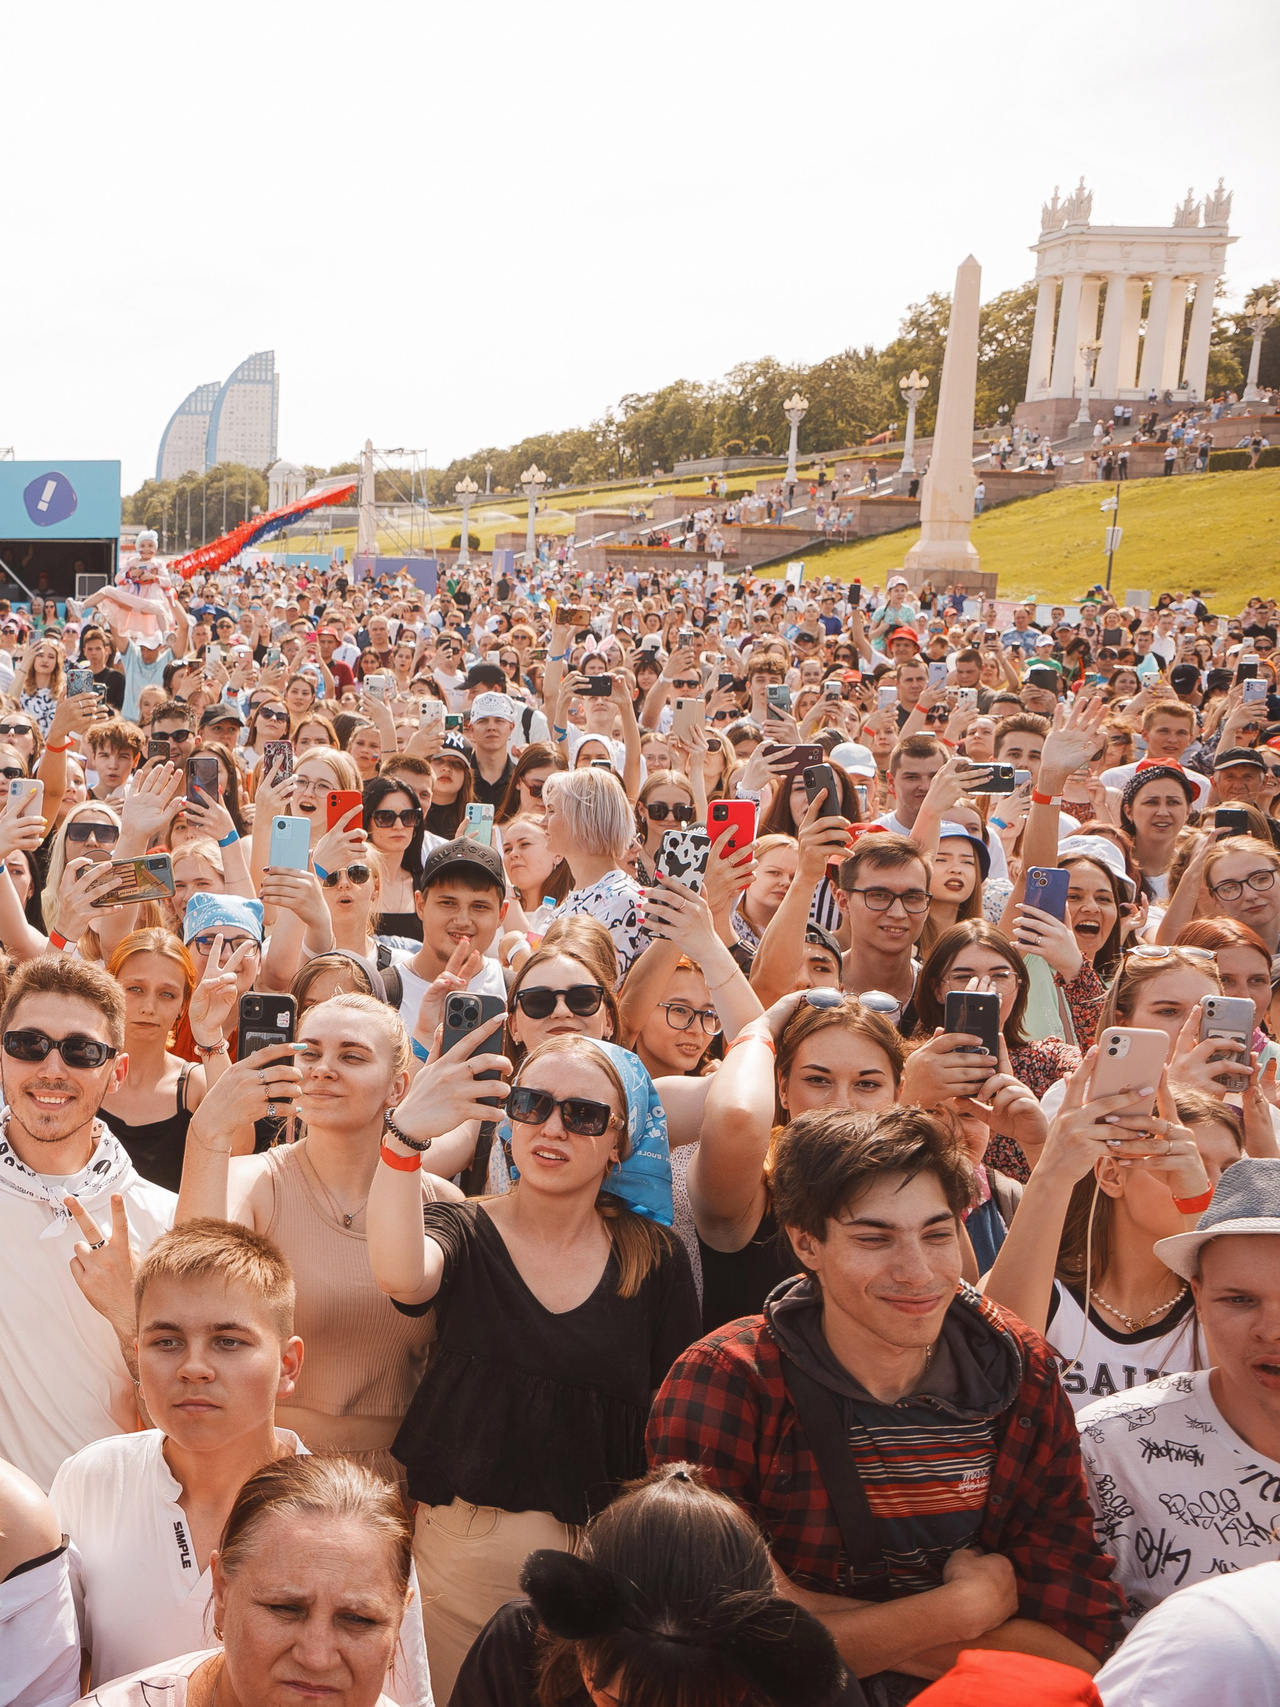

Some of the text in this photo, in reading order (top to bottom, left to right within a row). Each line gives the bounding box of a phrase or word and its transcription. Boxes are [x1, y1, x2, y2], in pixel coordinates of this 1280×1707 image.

[445, 731, 465, 749] NY
[1059, 1358, 1173, 1397] SAI
[172, 1520, 192, 1570] SIMPLE
